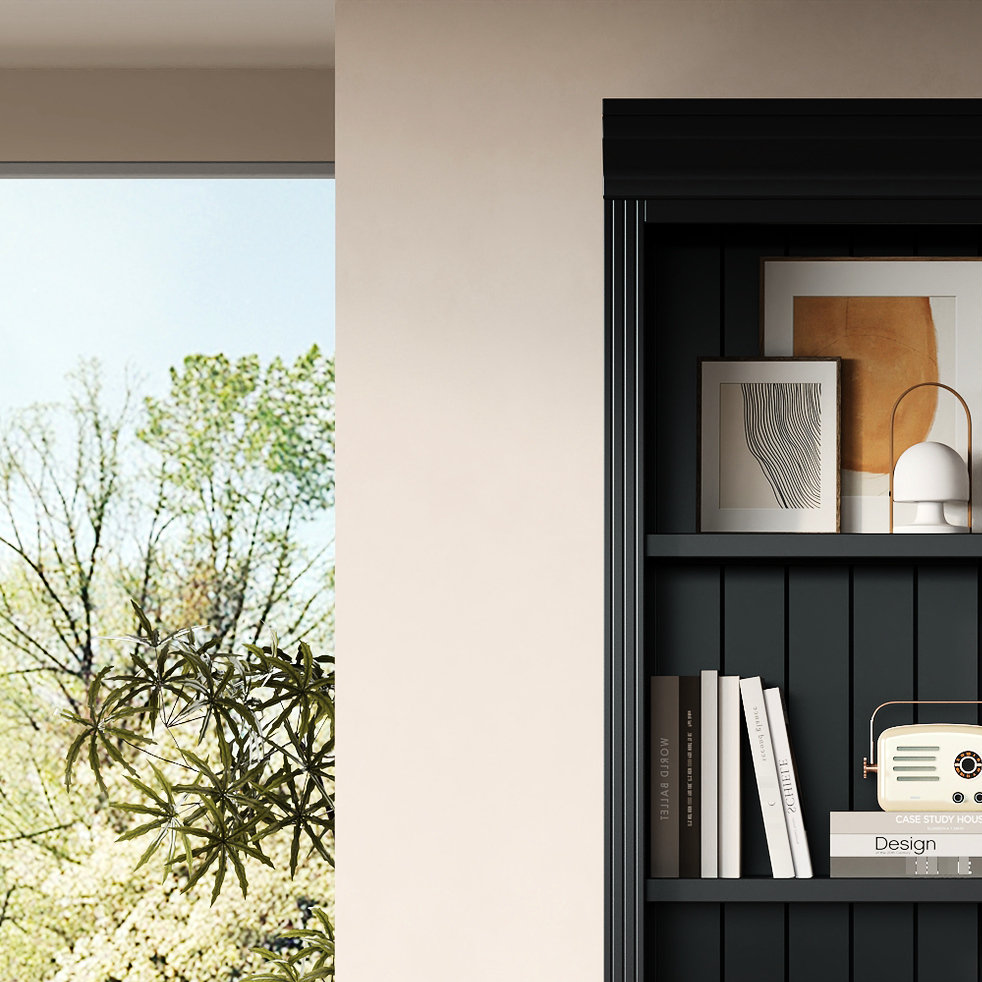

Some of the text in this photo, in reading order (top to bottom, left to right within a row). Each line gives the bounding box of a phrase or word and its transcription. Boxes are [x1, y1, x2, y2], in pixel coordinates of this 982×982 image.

[895, 814, 921, 824] CASE
[923, 814, 955, 824] STUDY
[875, 836, 937, 856] Design
